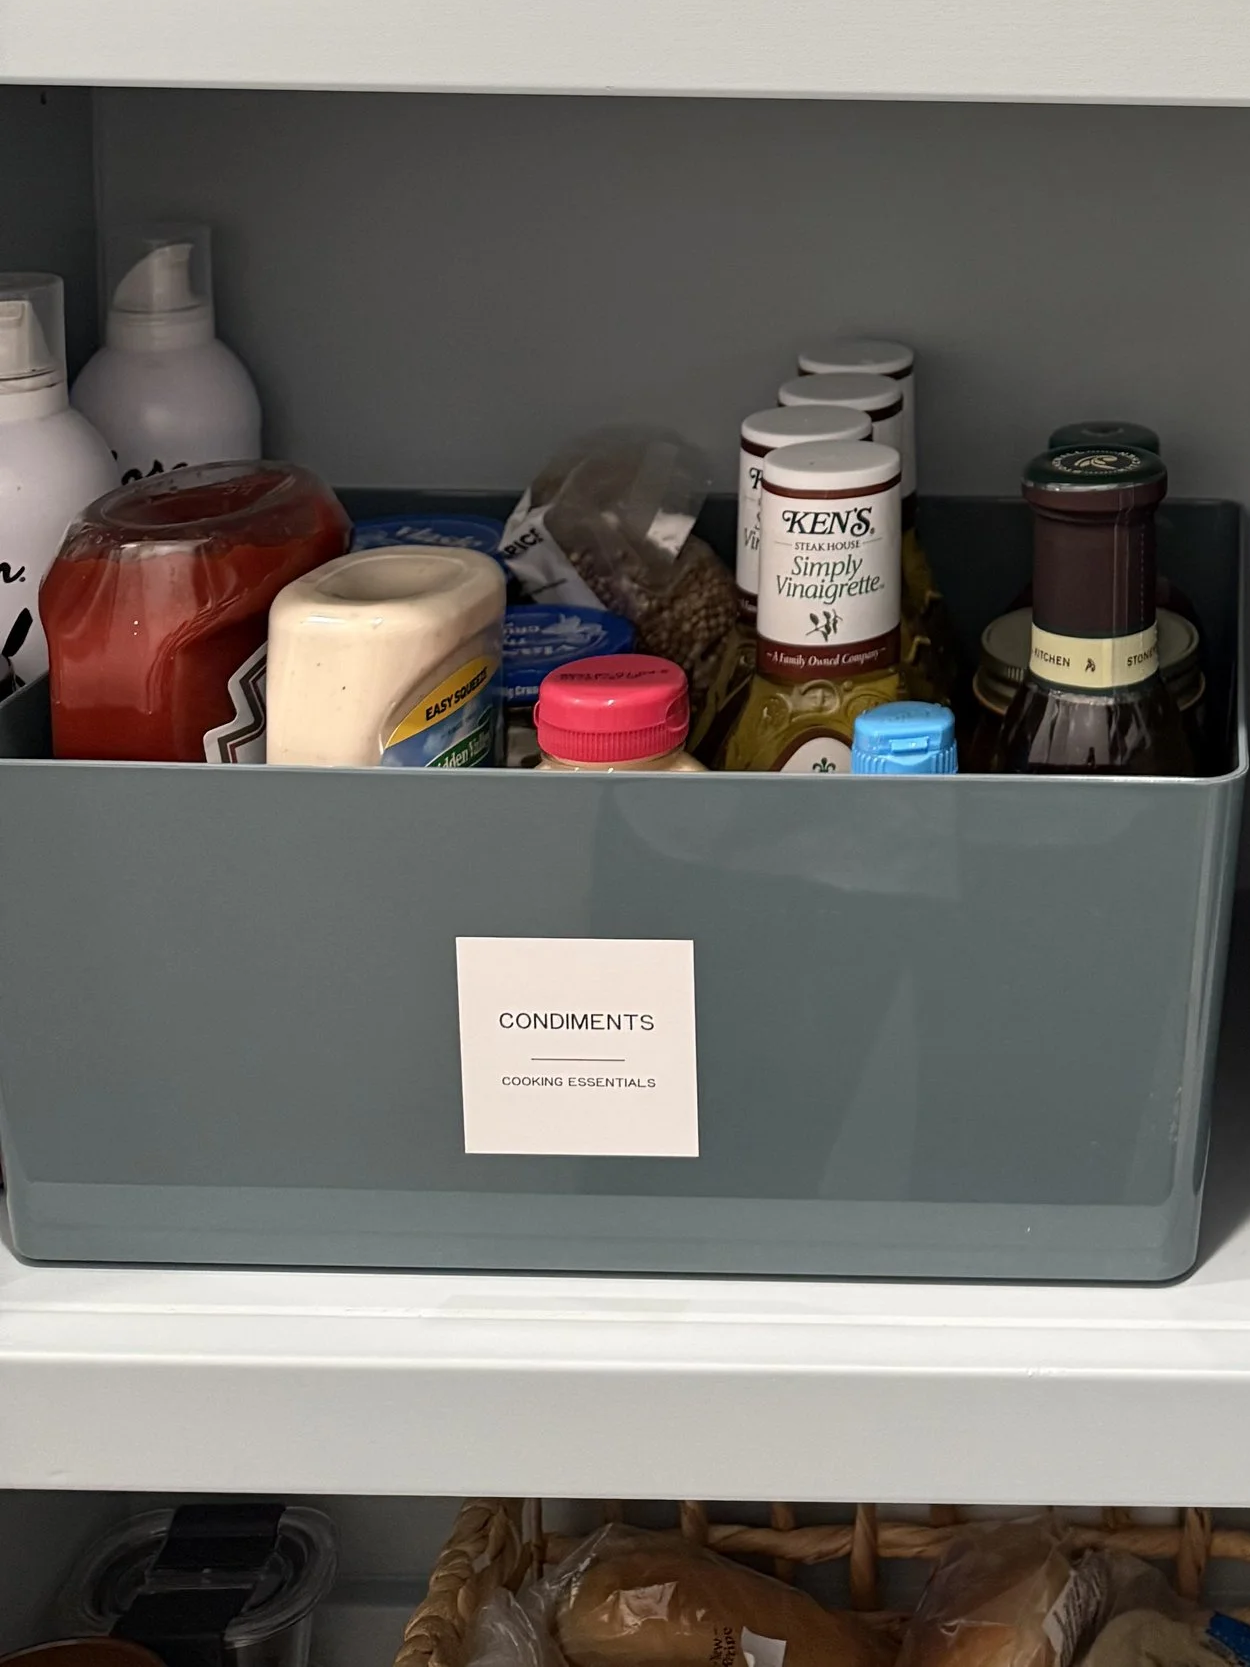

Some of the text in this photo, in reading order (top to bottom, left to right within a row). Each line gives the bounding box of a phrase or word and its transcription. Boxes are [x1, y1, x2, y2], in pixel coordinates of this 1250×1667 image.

[782, 507, 873, 537] KEN'S
[794, 540, 860, 551] STEAK HOUSE
[791, 554, 863, 583] Simply
[776, 575, 880, 605] Vinaigrette
[779, 652, 805, 669] Family
[808, 655, 840, 666] Owned
[841, 649, 879, 666] Company
[425, 693, 454, 722] EASY
[499, 1012, 655, 1031] CONDIMENTS
[502, 1076, 656, 1088] COOKING ESSENTIALS
